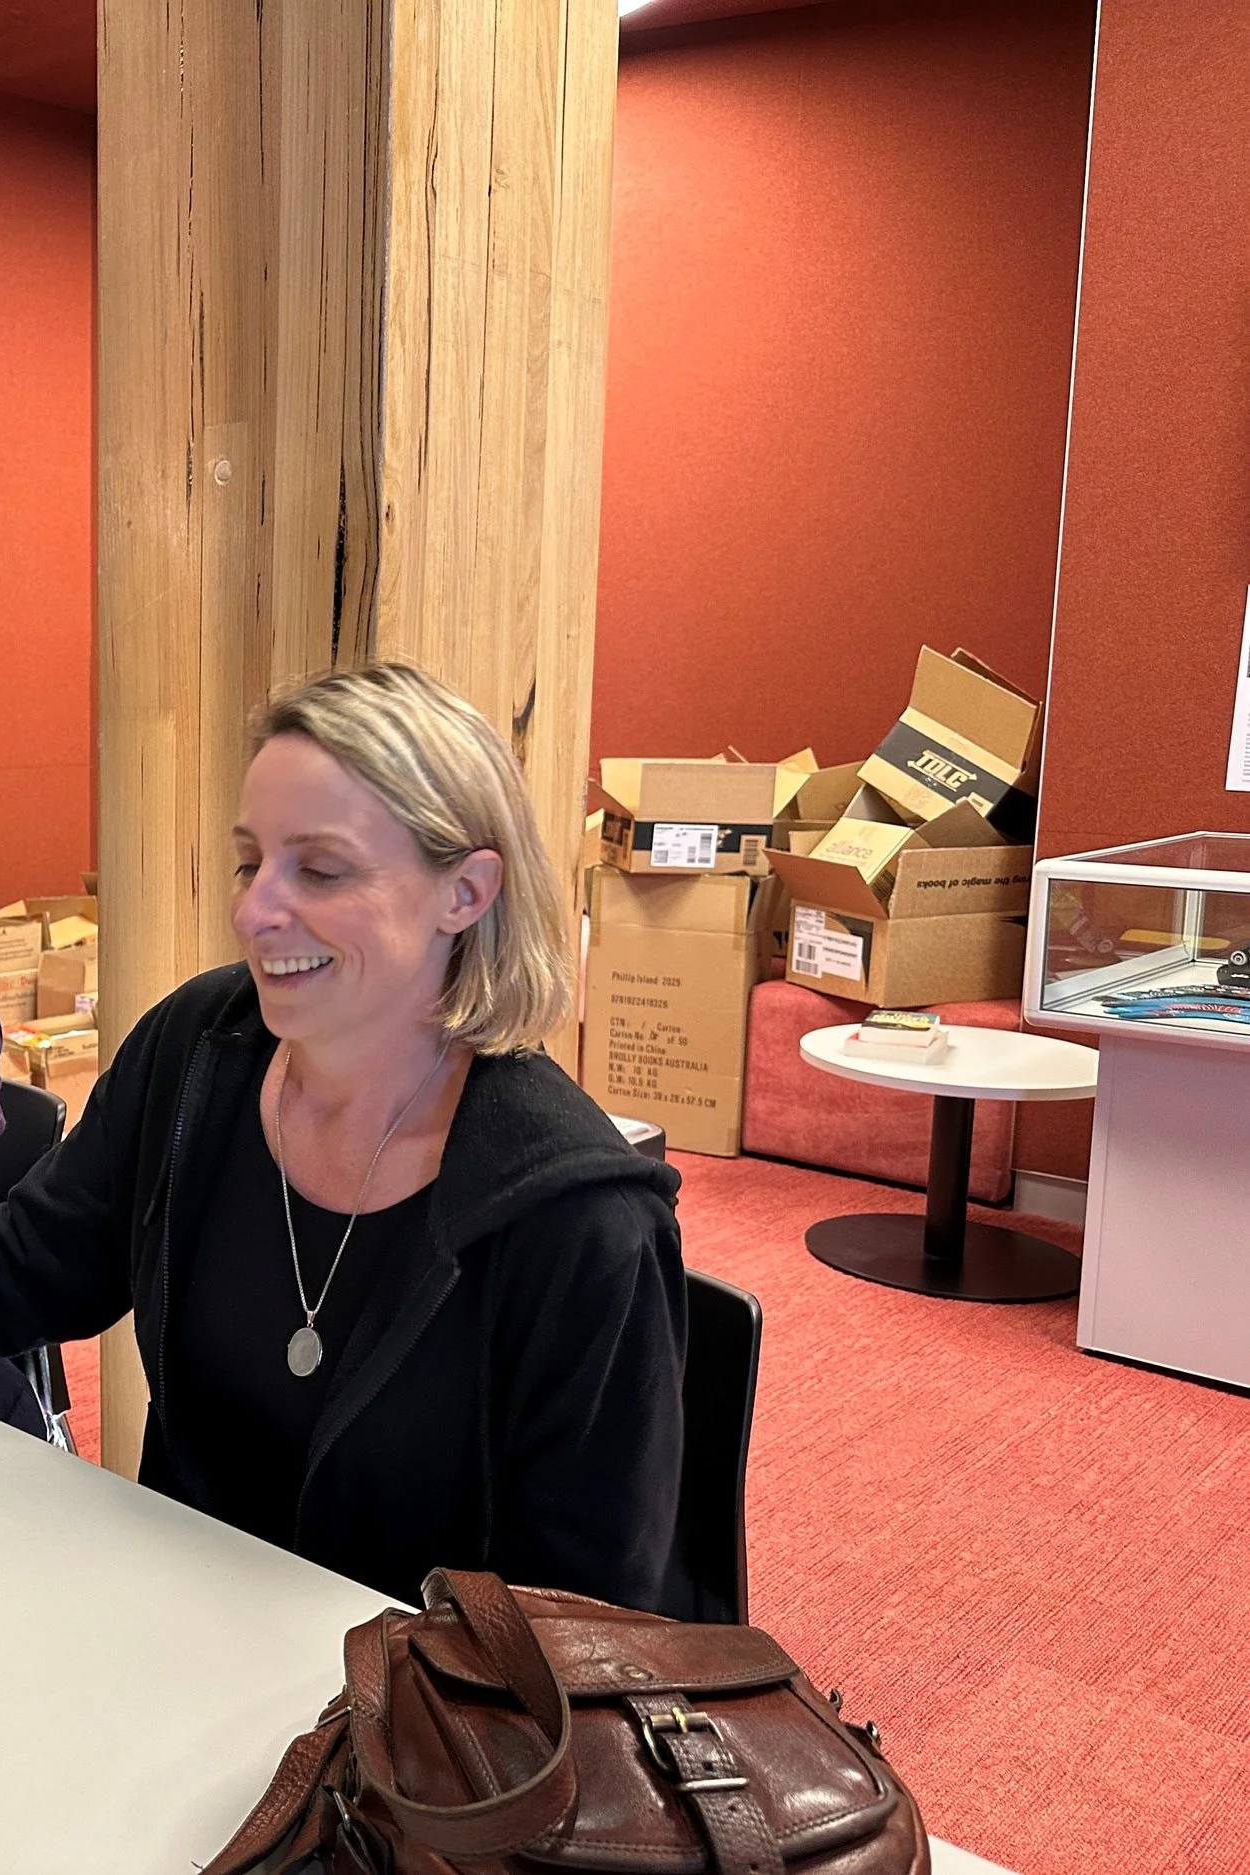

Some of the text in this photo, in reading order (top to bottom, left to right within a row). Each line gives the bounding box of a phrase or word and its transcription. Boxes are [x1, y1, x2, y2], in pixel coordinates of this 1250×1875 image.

[917, 880, 946, 889] books
[948, 879, 959, 888] of
[962, 877, 991, 888] magic
[994, 877, 1009, 886] the
[611, 971, 635, 983] Phillip
[637, 974, 658, 984] Island
[610, 1028, 633, 1039] Carton
[609, 1039, 666, 1055] Printed in China
[609, 1051, 708, 1071] BROLLY BOOKS AUSTRALIA
[608, 1085, 631, 1096] Carton
[704, 1098, 716, 1108] CM
